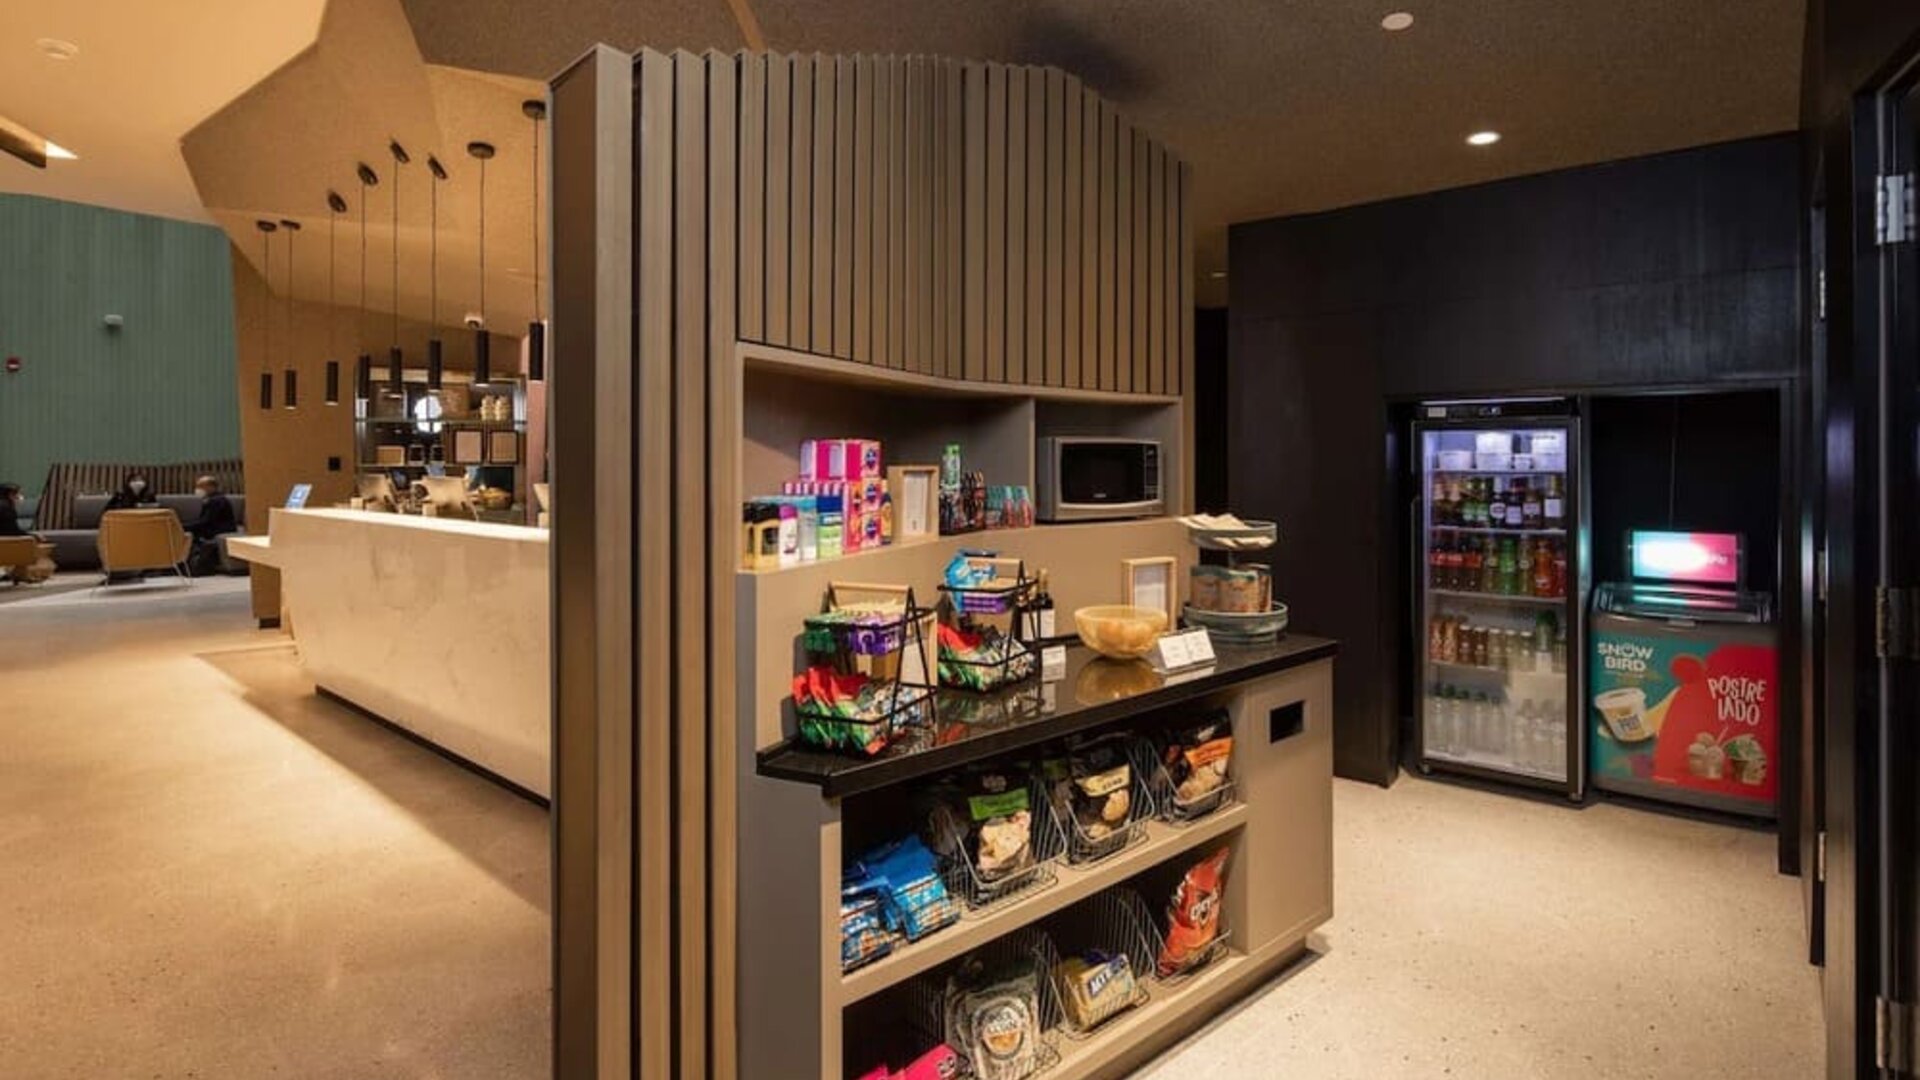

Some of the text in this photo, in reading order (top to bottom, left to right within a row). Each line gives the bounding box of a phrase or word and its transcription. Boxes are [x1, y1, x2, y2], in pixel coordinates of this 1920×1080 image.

[1597, 642, 1653, 660] SNOW
[1604, 656, 1647, 672] BIRD
[1707, 675, 1767, 702] POSTRE
[1717, 697, 1760, 726] LADO
